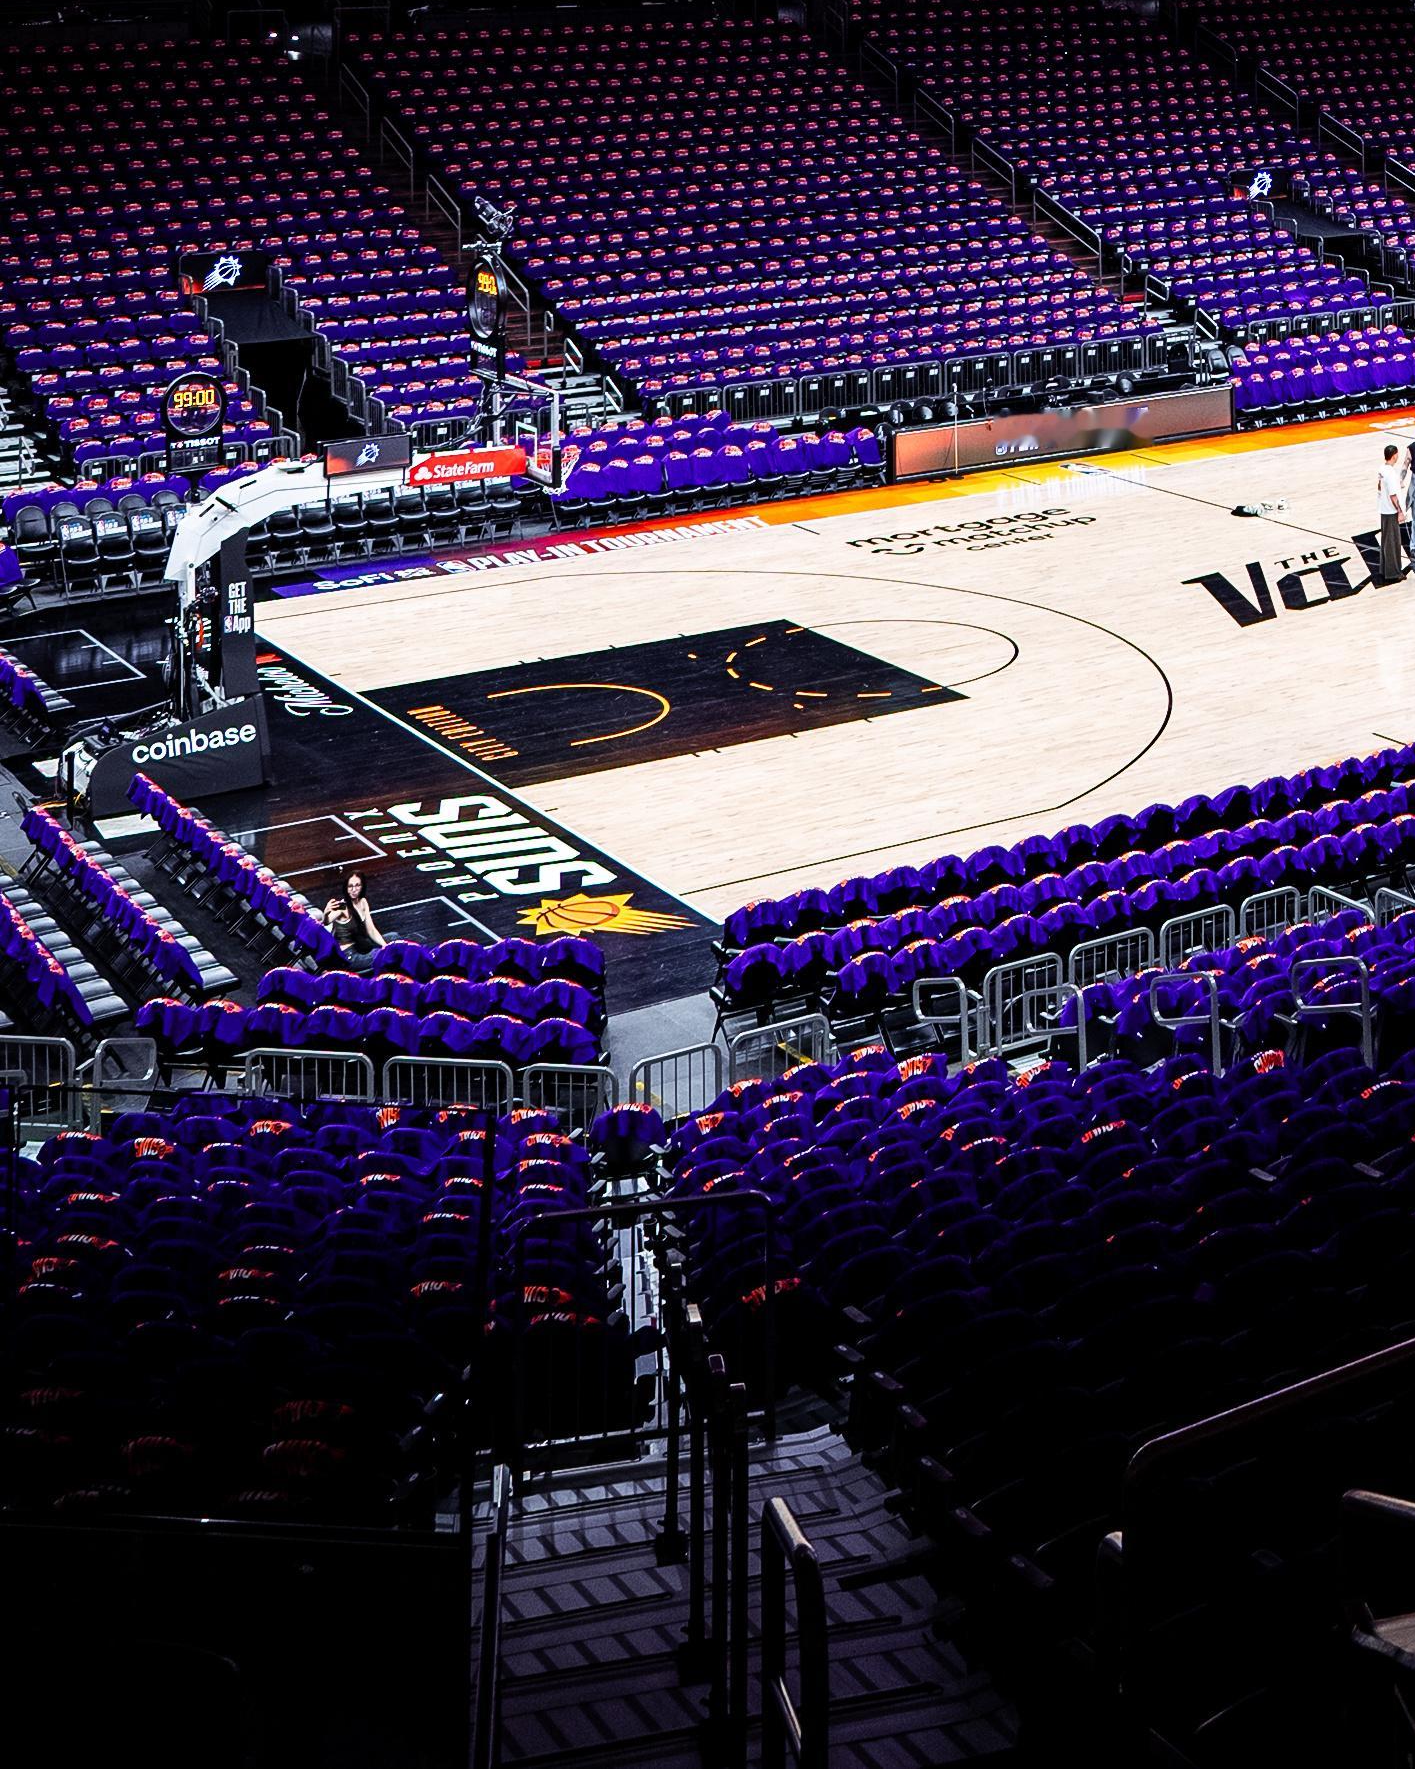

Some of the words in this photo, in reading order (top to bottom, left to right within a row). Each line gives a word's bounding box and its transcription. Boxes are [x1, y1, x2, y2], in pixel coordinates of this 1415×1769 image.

[173, 387, 215, 409] 99:00
[183, 436, 220, 448] TISSOT
[846, 508, 1072, 549] mortgage
[933, 516, 1097, 548] matchup
[312, 571, 395, 591] SoFi
[468, 541, 588, 571] PLAY-IN
[586, 516, 771, 555] TOURNAMENT
[965, 532, 1056, 553] center
[1274, 546, 1341, 571] THE
[228, 581, 247, 599] GET
[228, 598, 247, 615] THE
[233, 615, 251, 634] App
[132, 724, 257, 764] coinbase
[344, 808, 500, 904] PHOENIX
[387, 795, 618, 896] SUNS
